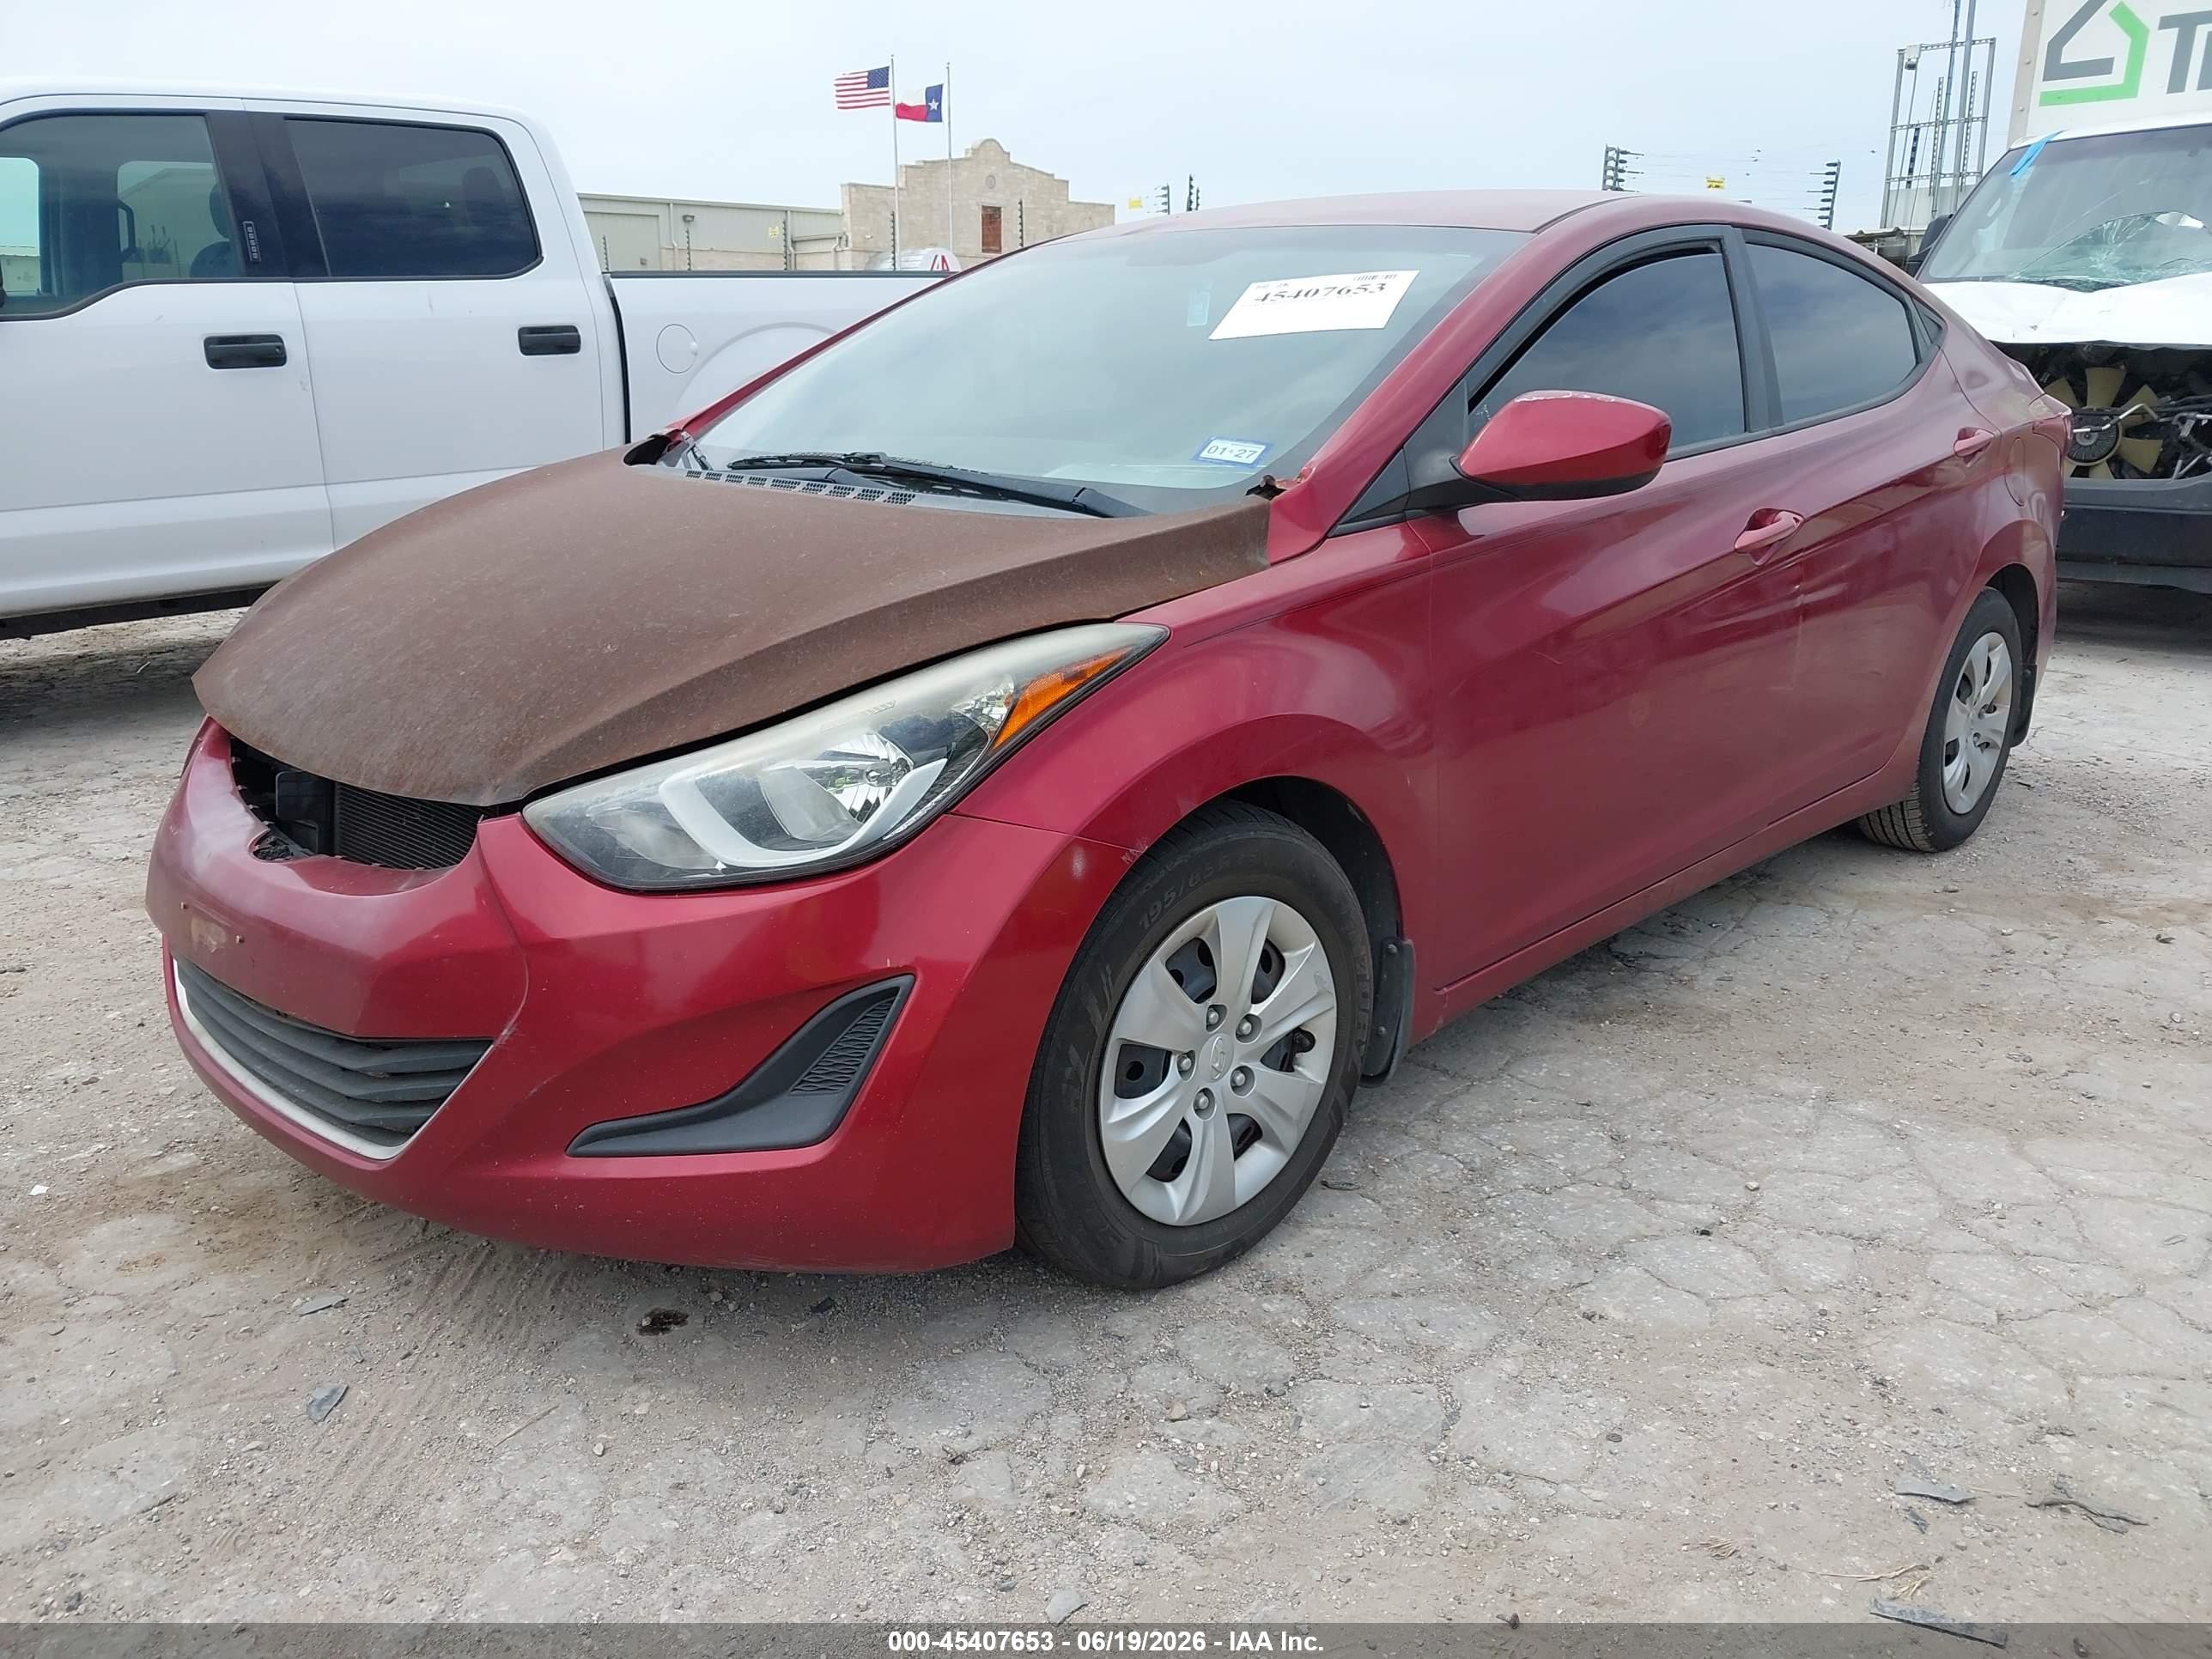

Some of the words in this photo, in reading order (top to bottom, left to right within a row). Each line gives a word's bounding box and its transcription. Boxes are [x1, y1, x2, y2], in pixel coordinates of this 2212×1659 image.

[2158, 9, 2212, 94] T
[1254, 283, 1387, 302] 45407653
[1206, 445, 1228, 456] 01
[1234, 448, 1259, 459] 27
